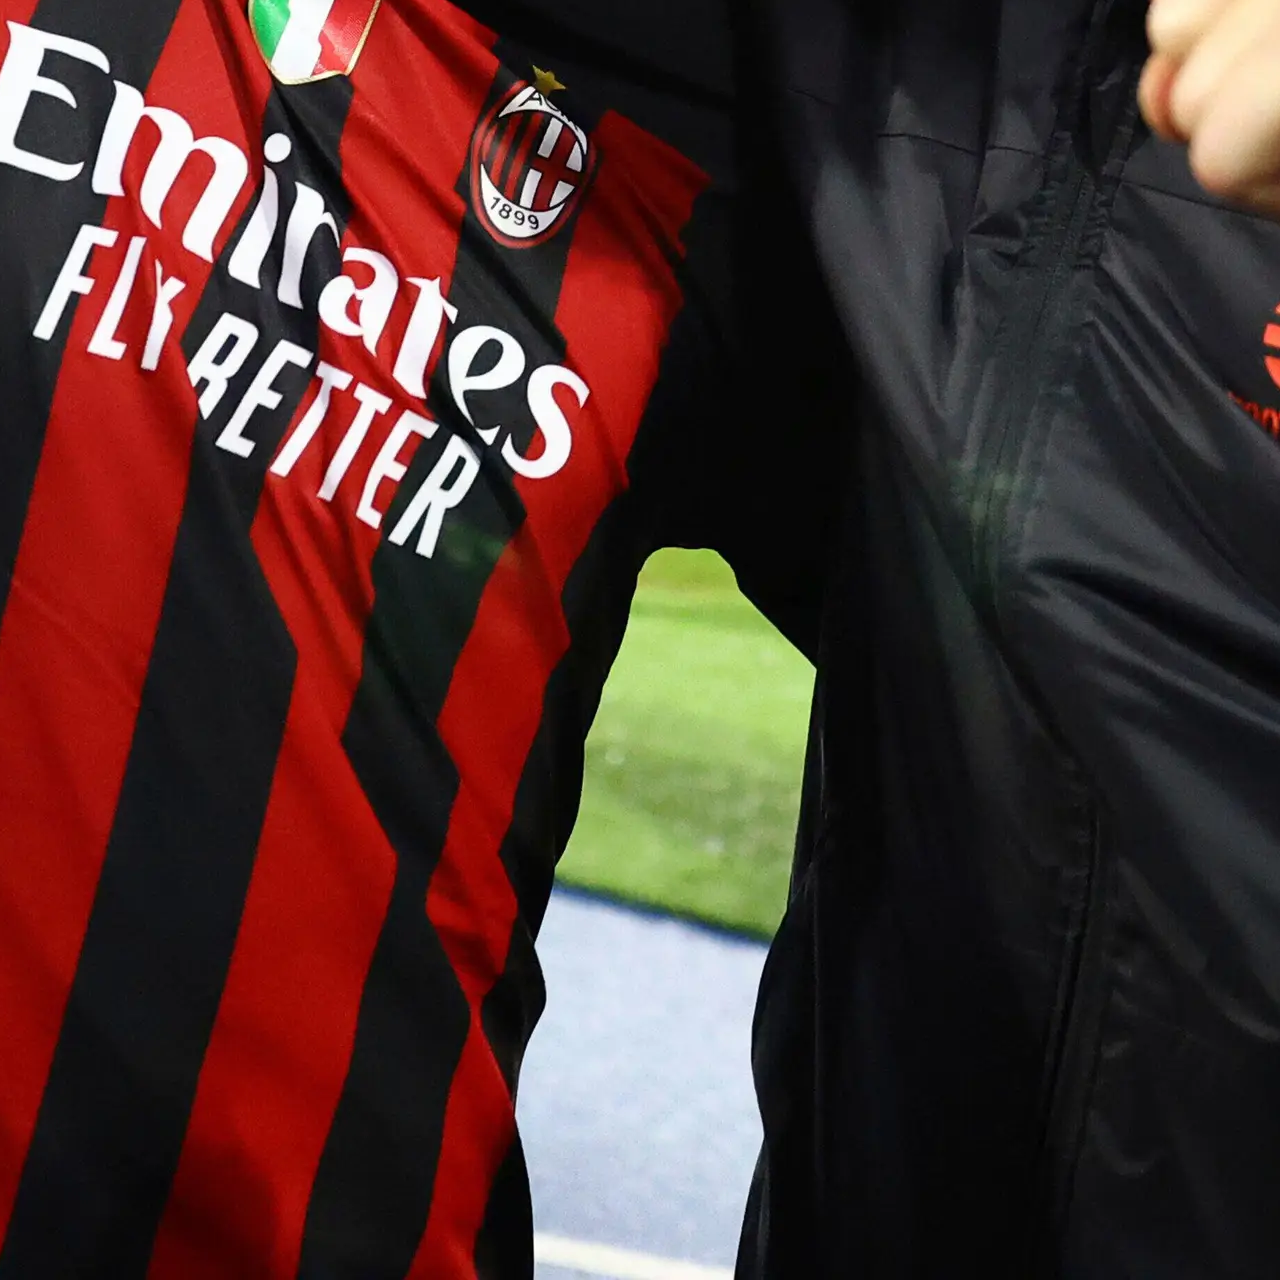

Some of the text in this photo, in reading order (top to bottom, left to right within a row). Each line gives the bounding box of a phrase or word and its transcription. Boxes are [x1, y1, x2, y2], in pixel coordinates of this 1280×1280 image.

[490, 196, 541, 231] 1899
[31, 223, 482, 559] FLY BETTER
